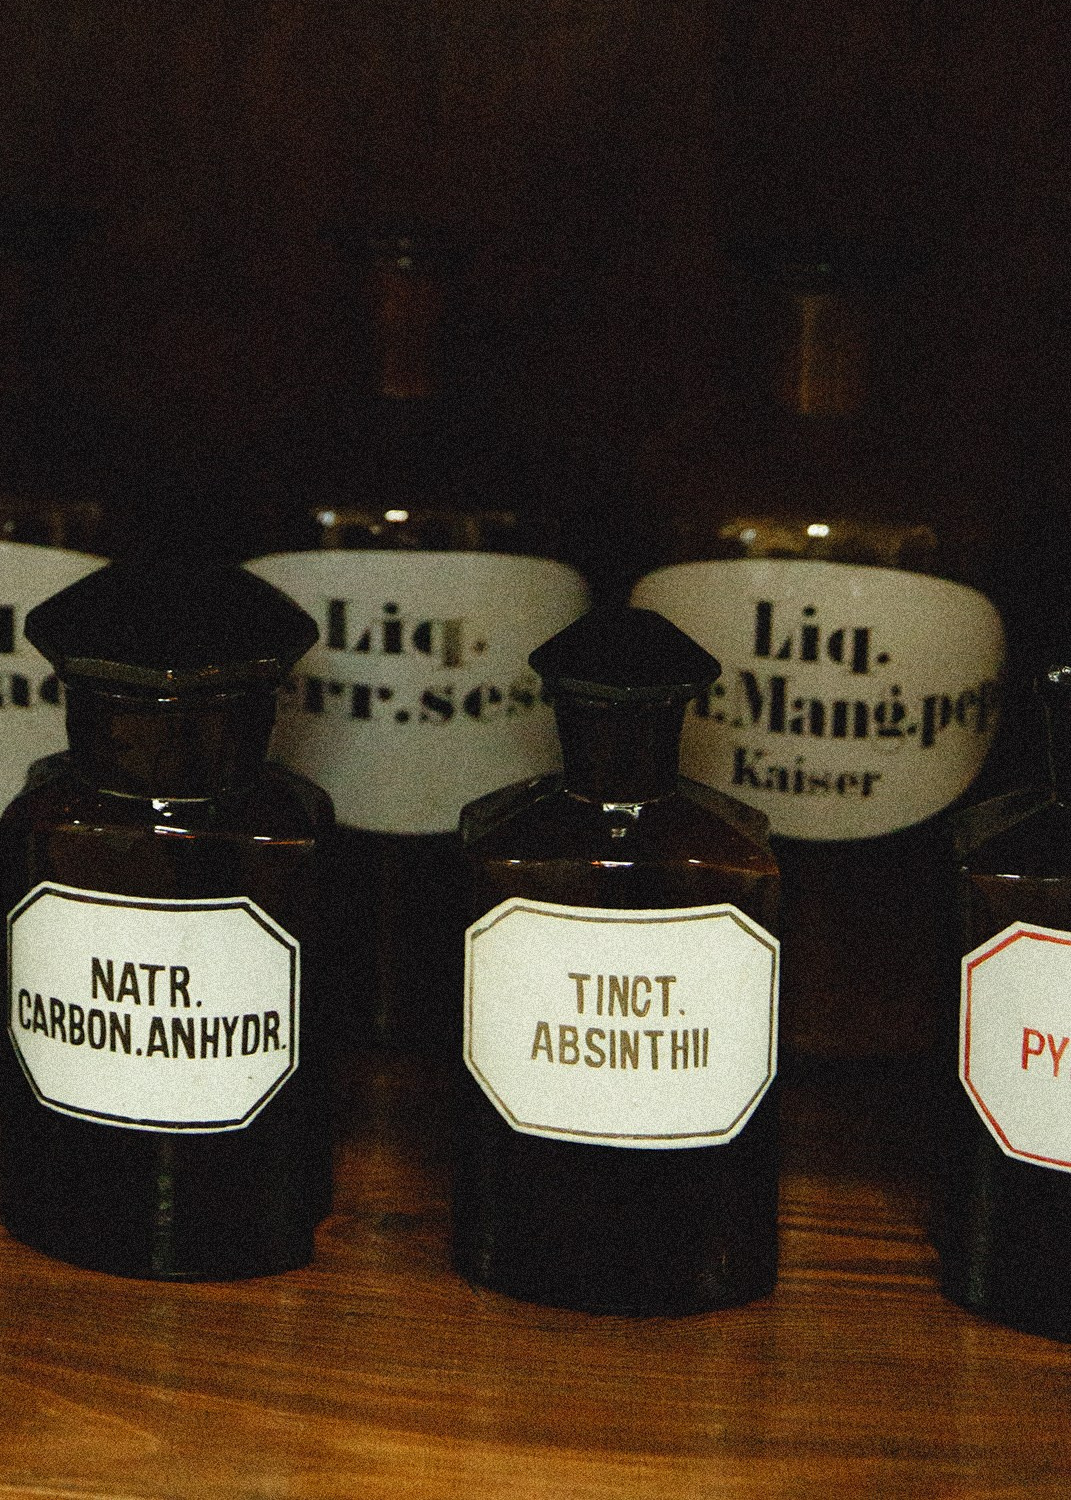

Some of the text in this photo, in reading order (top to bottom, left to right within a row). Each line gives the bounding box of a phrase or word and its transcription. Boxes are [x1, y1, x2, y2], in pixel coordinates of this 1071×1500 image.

[754, 600, 892, 676] Liq.
[730, 745, 883, 797] Kaiser
[90, 956, 203, 1008] NATR.
[567, 971, 685, 1018] TINCT.
[530, 1020, 710, 1071] ABSINTHII
